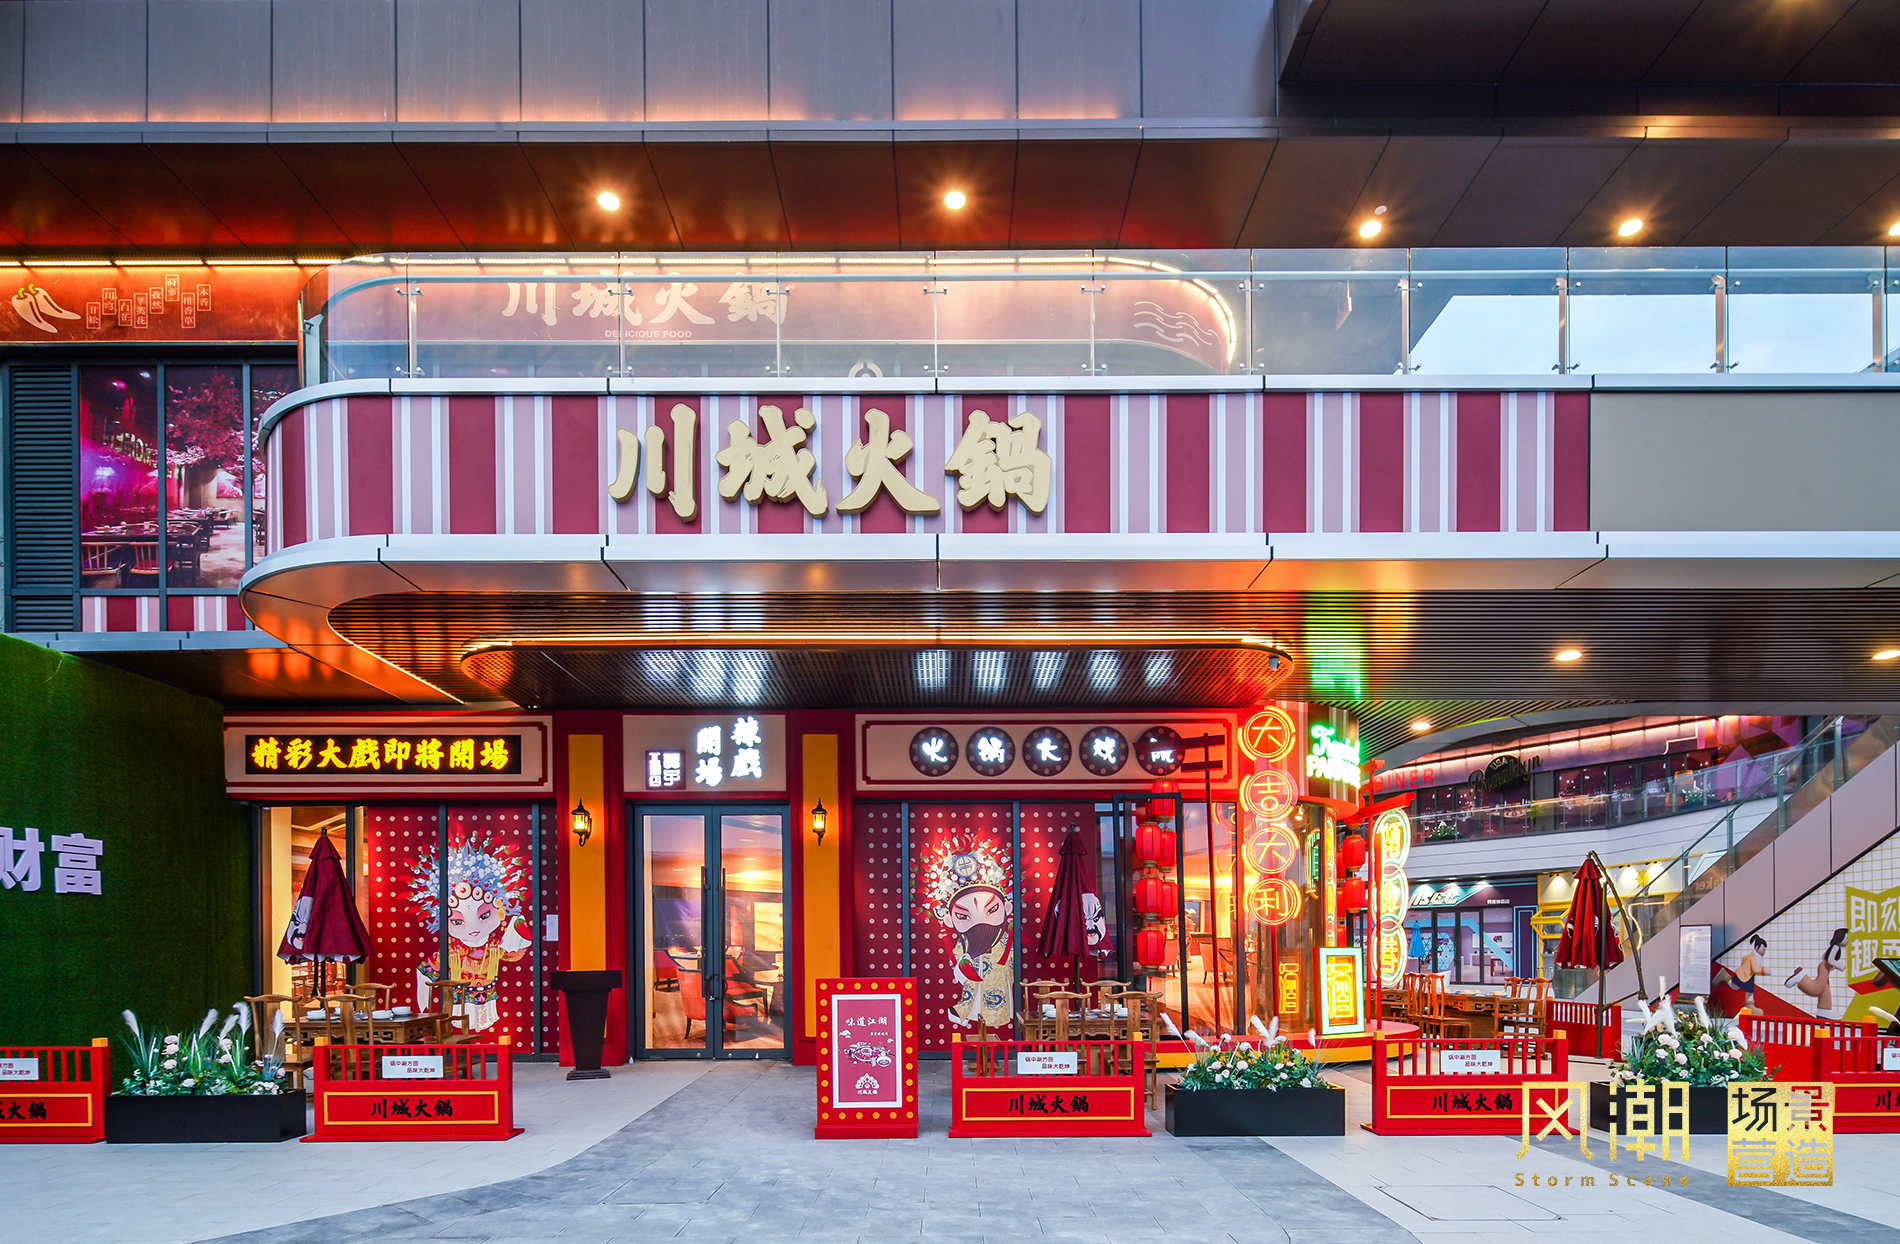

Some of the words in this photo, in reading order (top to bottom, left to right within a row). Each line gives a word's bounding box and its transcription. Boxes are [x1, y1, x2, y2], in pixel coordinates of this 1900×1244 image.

[604, 330, 660, 339] DEICIOUS
[663, 330, 692, 338] FOOD
[607, 403, 1054, 523] 川城火鍋
[250, 736, 511, 771] 精彩大戲即將開場
[1489, 756, 1509, 771] USA
[1373, 768, 1434, 793] DINER
[1468, 754, 1544, 796] Brooklyn
[1250, 716, 1290, 916] 大吉大利
[370, 1098, 453, 1119] 川城火鍋
[1008, 1094, 1090, 1115] 川城火鍋
[1432, 1092, 1513, 1113] 川城火鍋
